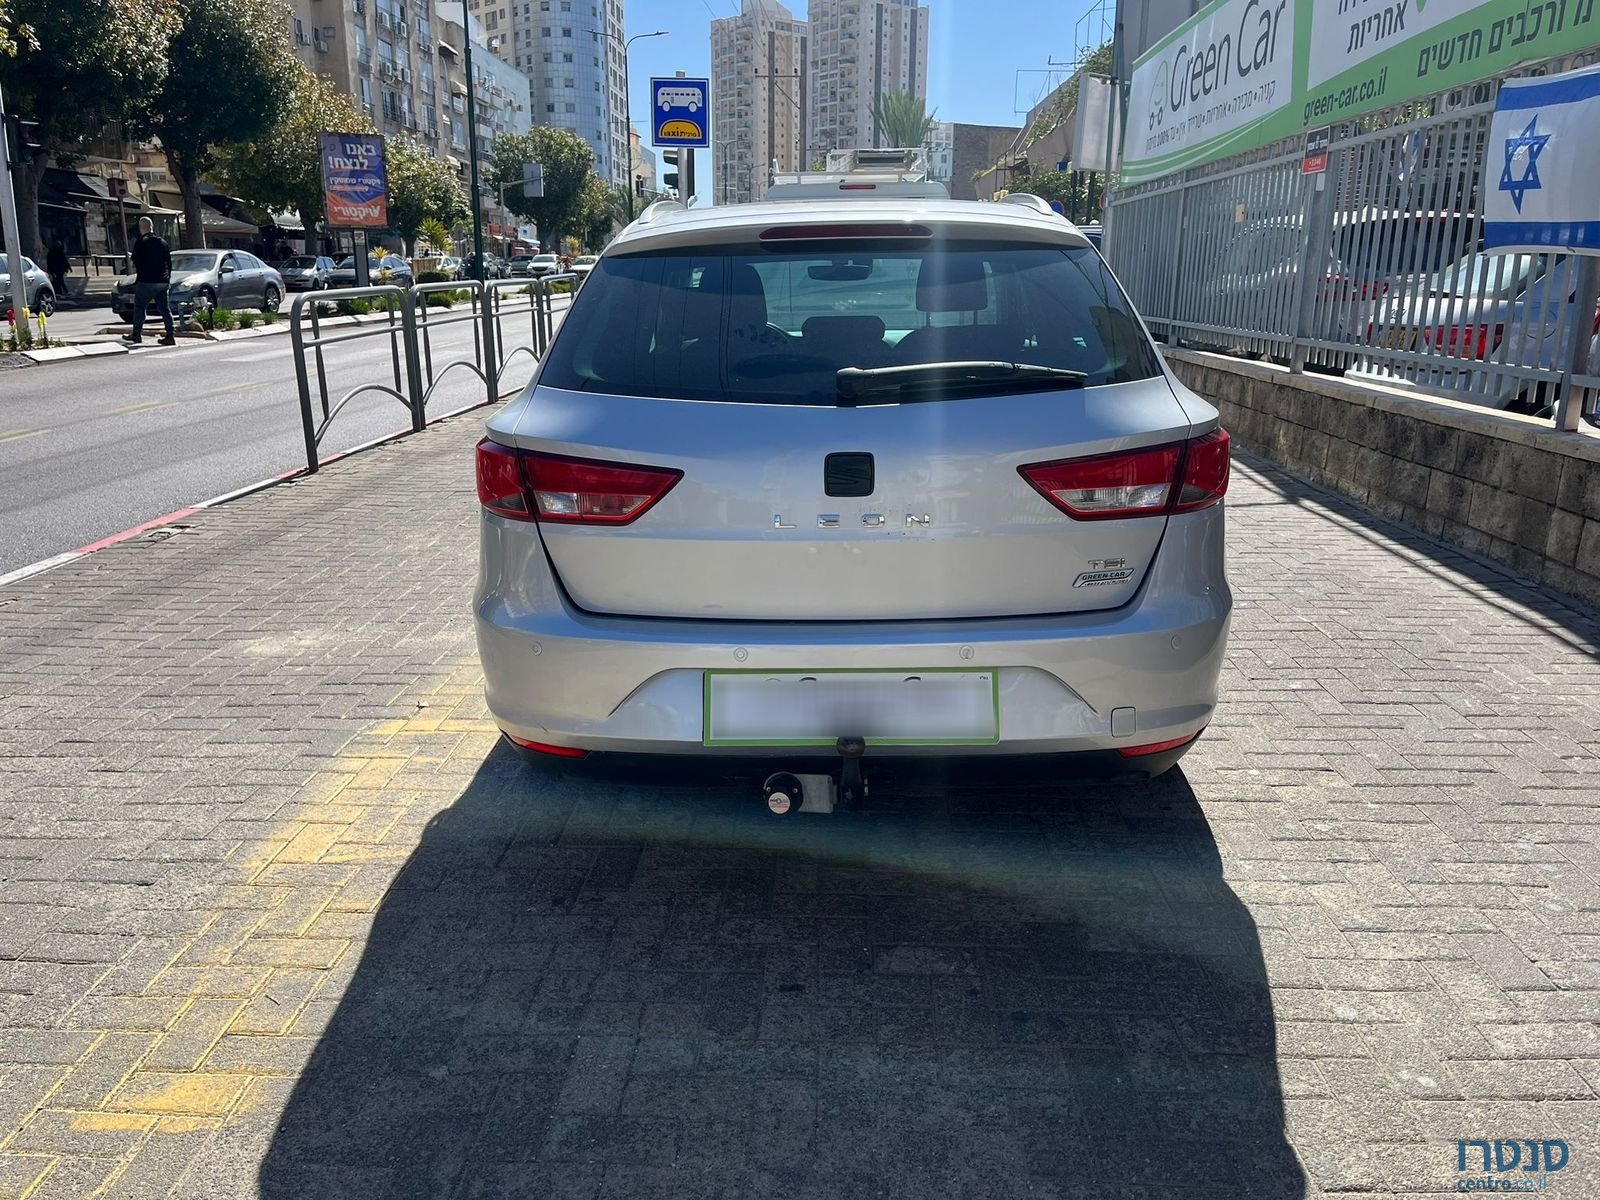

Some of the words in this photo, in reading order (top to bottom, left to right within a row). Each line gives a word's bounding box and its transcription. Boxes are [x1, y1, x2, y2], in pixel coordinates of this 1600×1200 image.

[1347, 0, 1408, 54] אחריות
[1488, 0, 1567, 54] ורכבים
[1170, 34, 1231, 112] Green
[1237, 0, 1286, 77] Car
[1417, 28, 1483, 78] חדשים
[1303, 66, 1388, 126] green-car.co.il
[328, 155, 369, 170] לנצח!
[345, 143, 376, 156] באנו
[773, 513, 931, 529] LEON
[1082, 573, 1108, 581] GREEN
[1087, 558, 1126, 569] TSI
